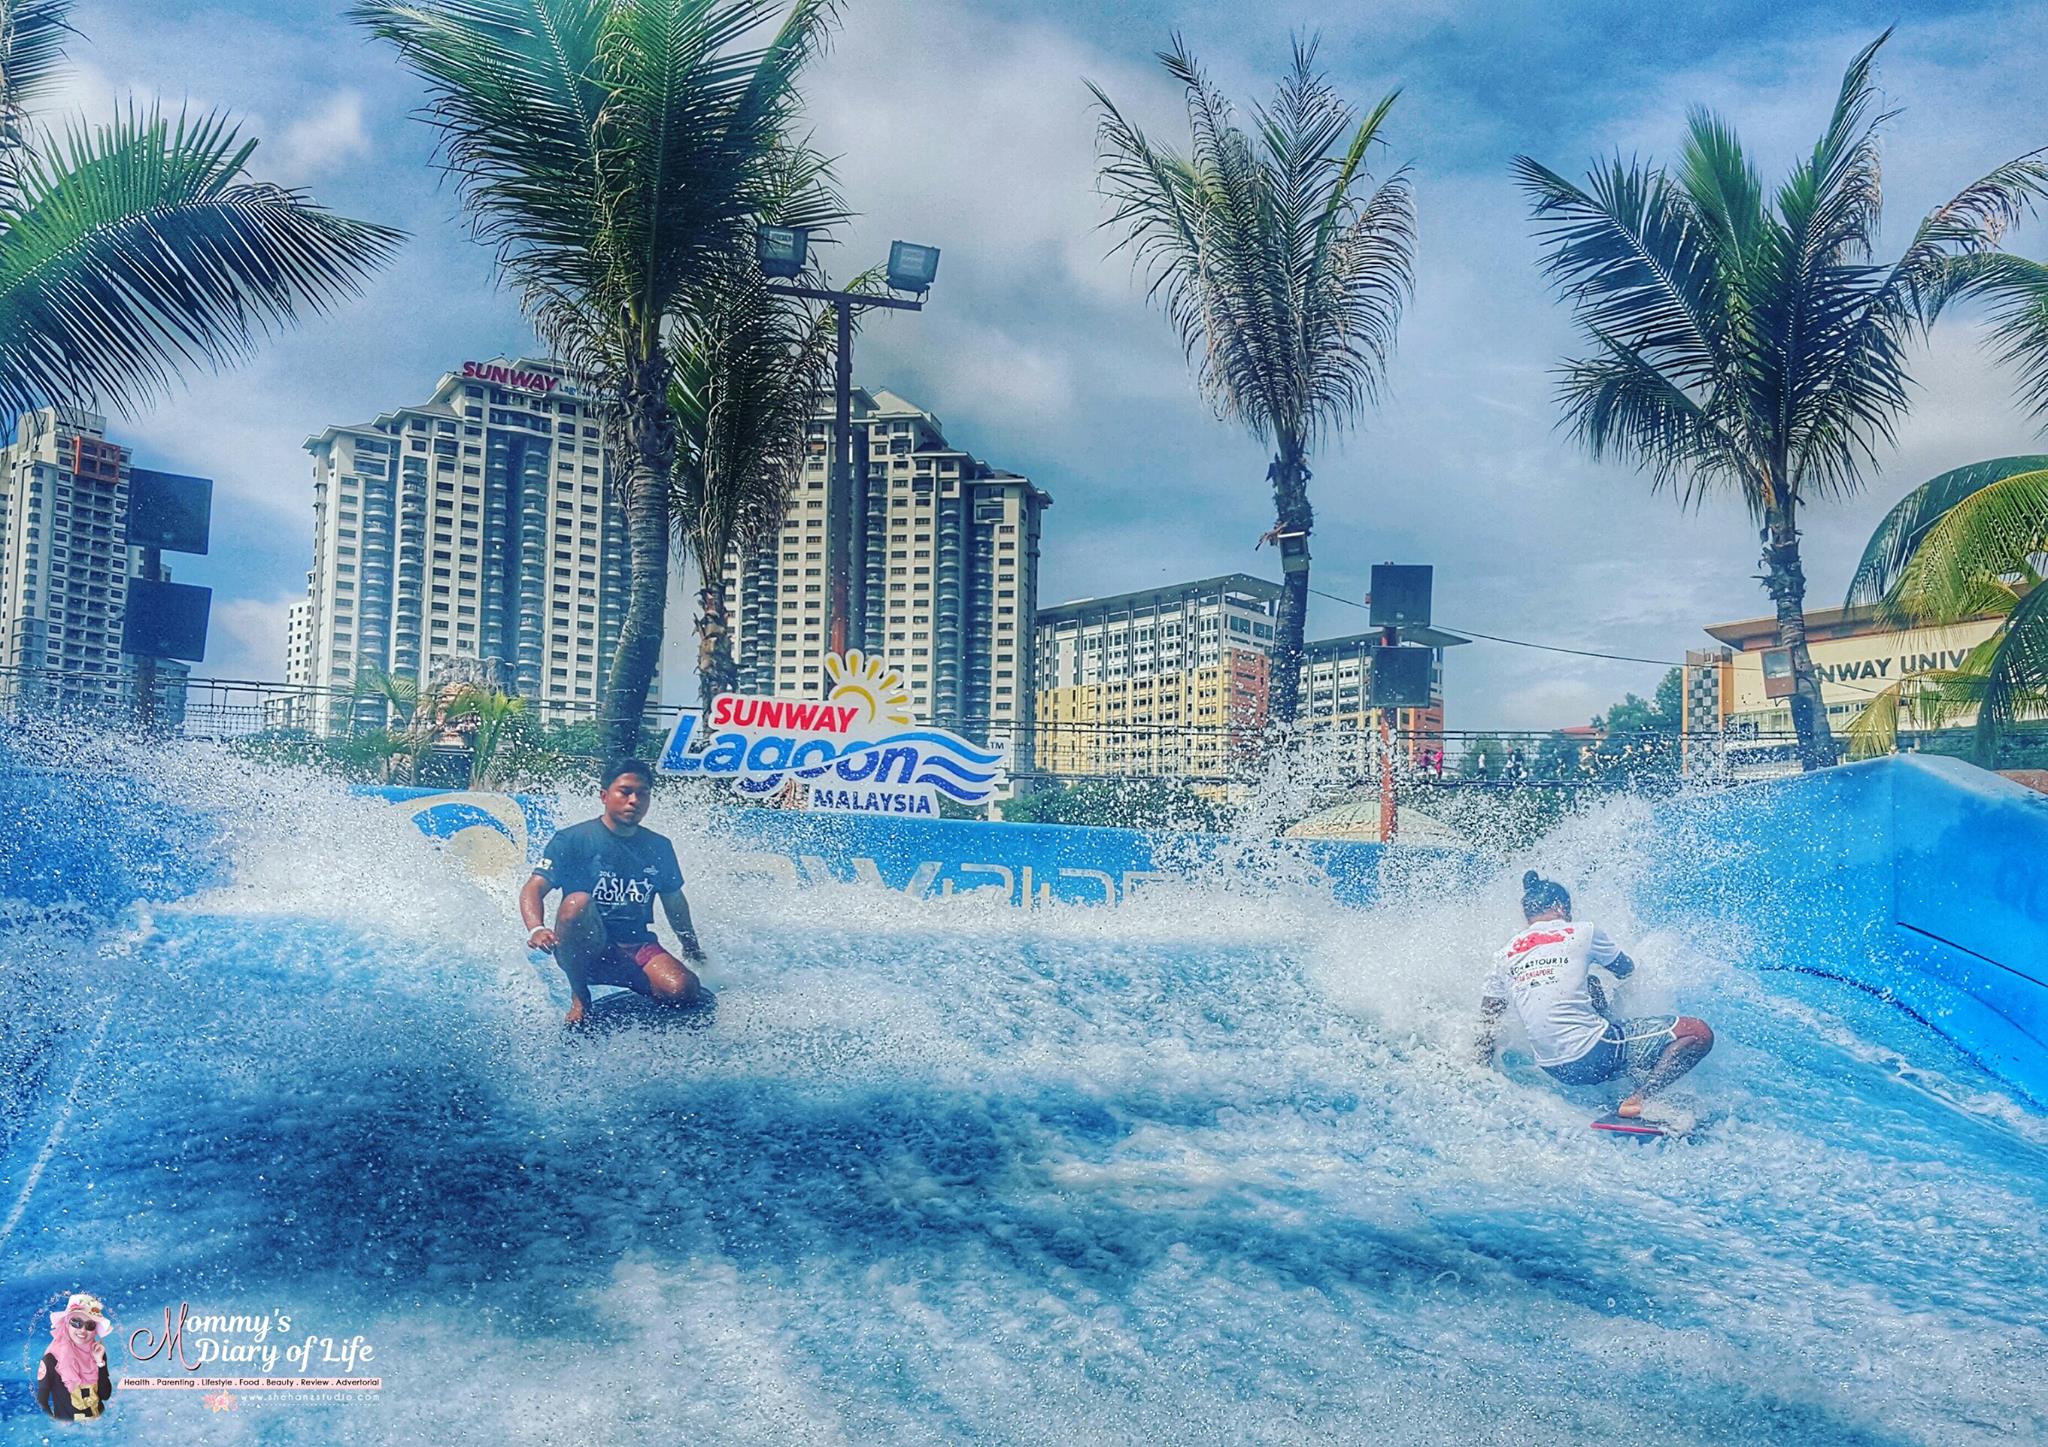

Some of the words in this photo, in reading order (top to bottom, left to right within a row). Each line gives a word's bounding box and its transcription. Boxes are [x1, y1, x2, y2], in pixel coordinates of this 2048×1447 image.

[463, 361, 559, 391] SUNWAY
[1816, 657, 1891, 683] NWAY
[714, 697, 859, 734] SUNWAY
[661, 714, 920, 795] Lagoon
[989, 741, 1005, 750] TM
[813, 788, 932, 815] MALAYSIA
[592, 890, 626, 902] FLOW
[594, 877, 640, 894] ASIA
